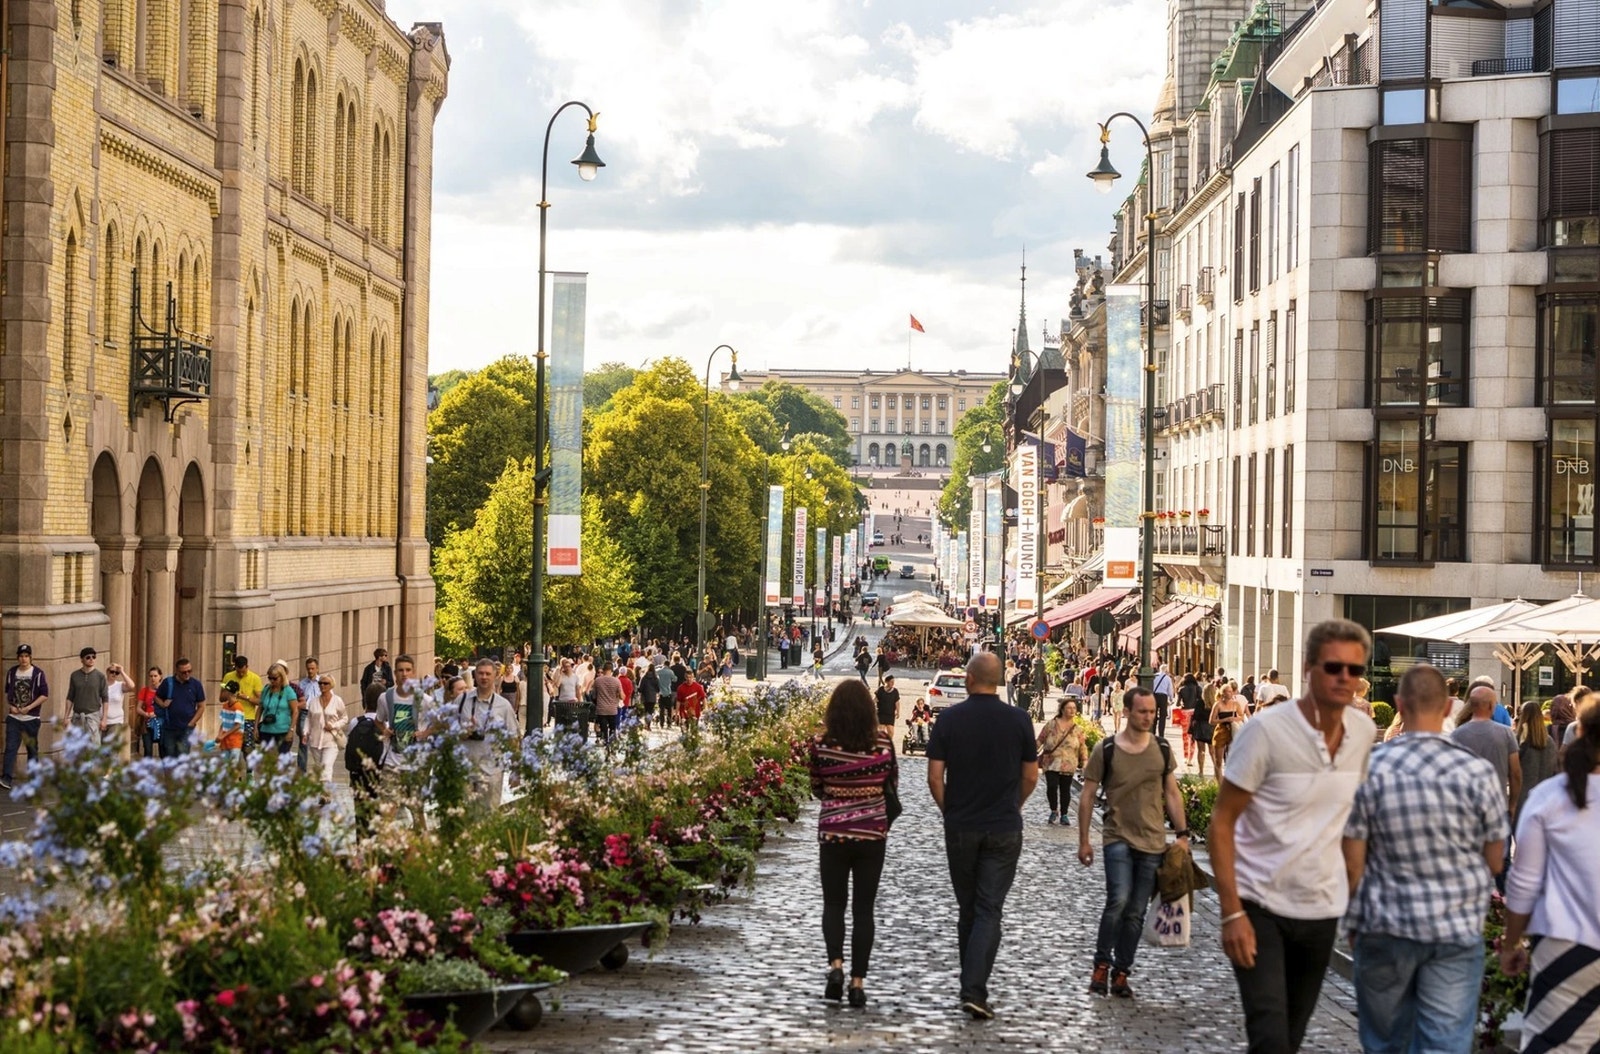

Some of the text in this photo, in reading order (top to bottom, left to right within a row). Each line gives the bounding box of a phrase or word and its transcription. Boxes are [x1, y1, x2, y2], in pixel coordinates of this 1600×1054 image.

[1021, 451, 1035, 477] VAN
[1383, 458, 1414, 473] DNB
[1556, 459, 1590, 474] DNB
[972, 513, 981, 529] VAN
